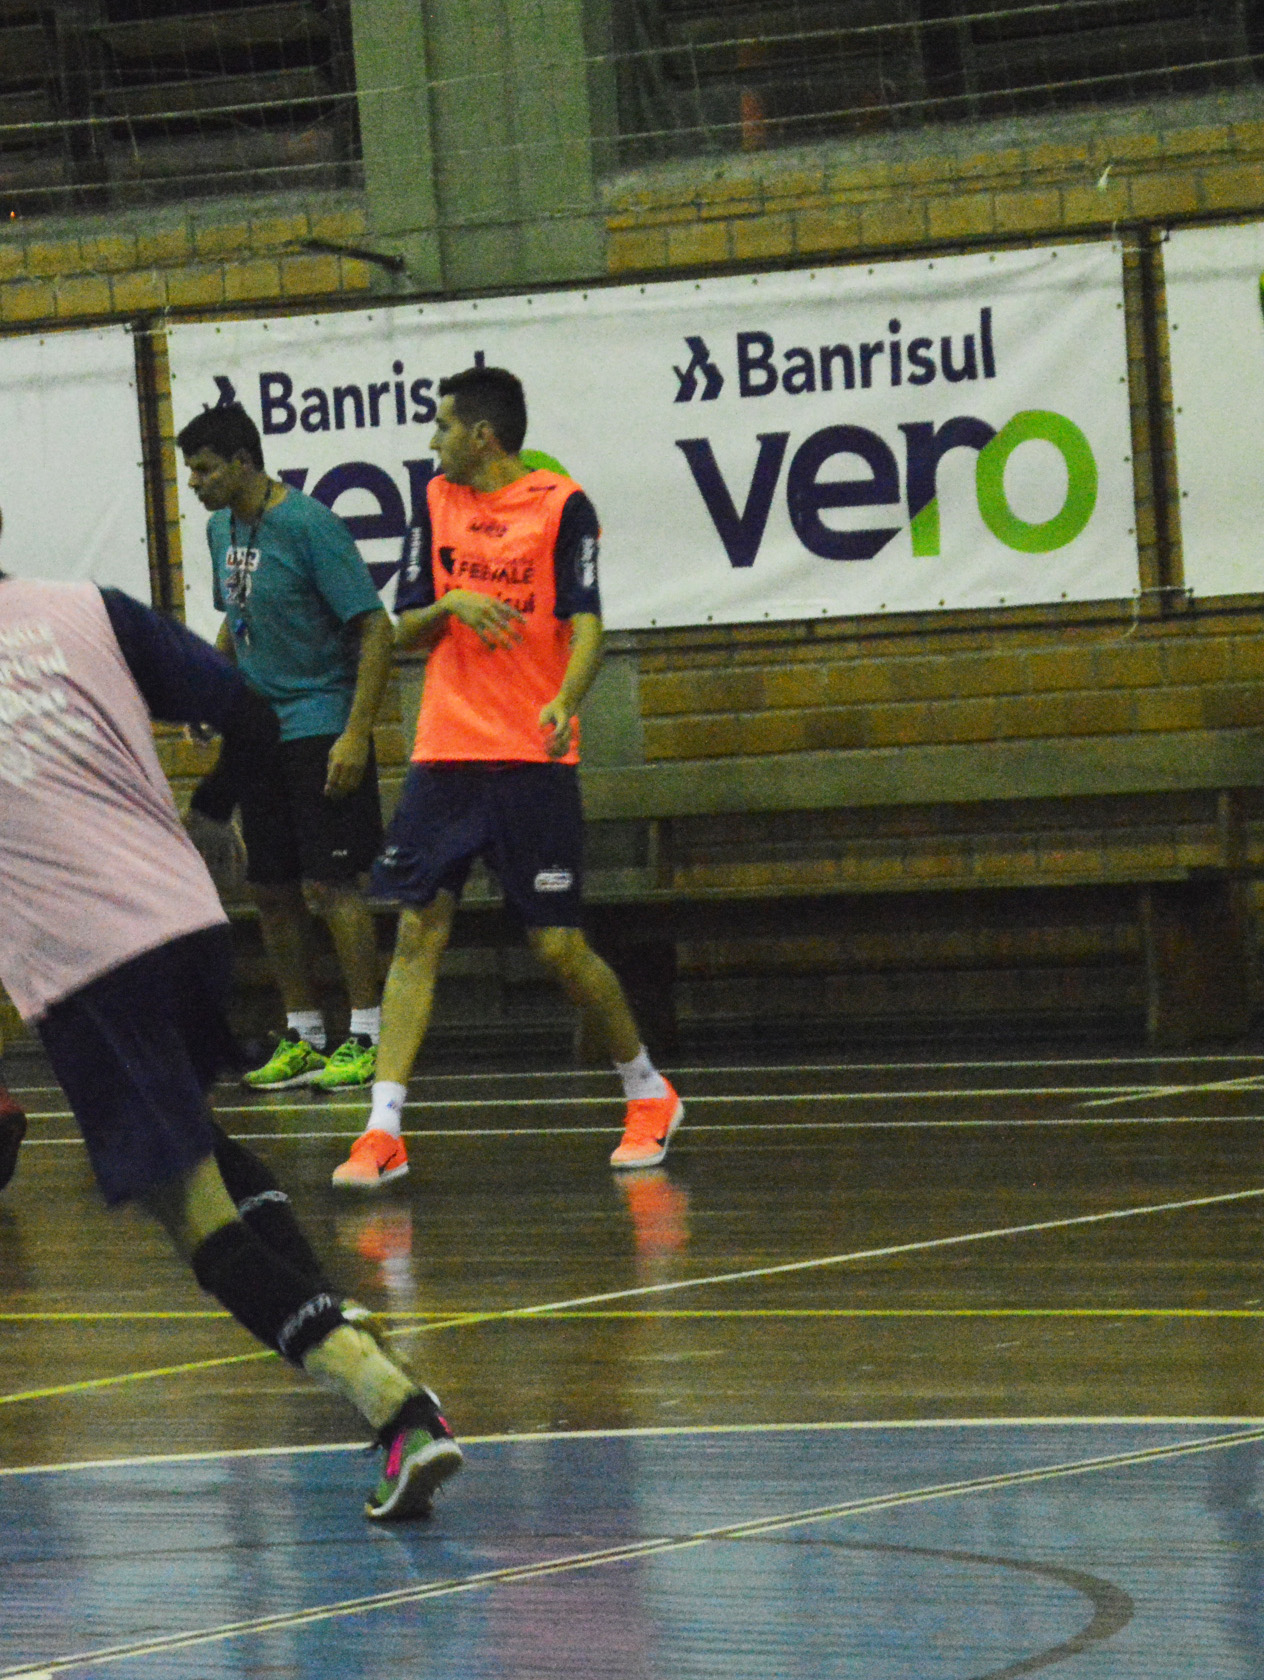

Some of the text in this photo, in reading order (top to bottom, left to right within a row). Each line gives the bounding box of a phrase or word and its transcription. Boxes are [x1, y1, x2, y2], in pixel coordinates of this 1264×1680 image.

[259, 350, 485, 435] Banris
[736, 306, 997, 399] Banrisul
[675, 408, 1099, 568] vero
